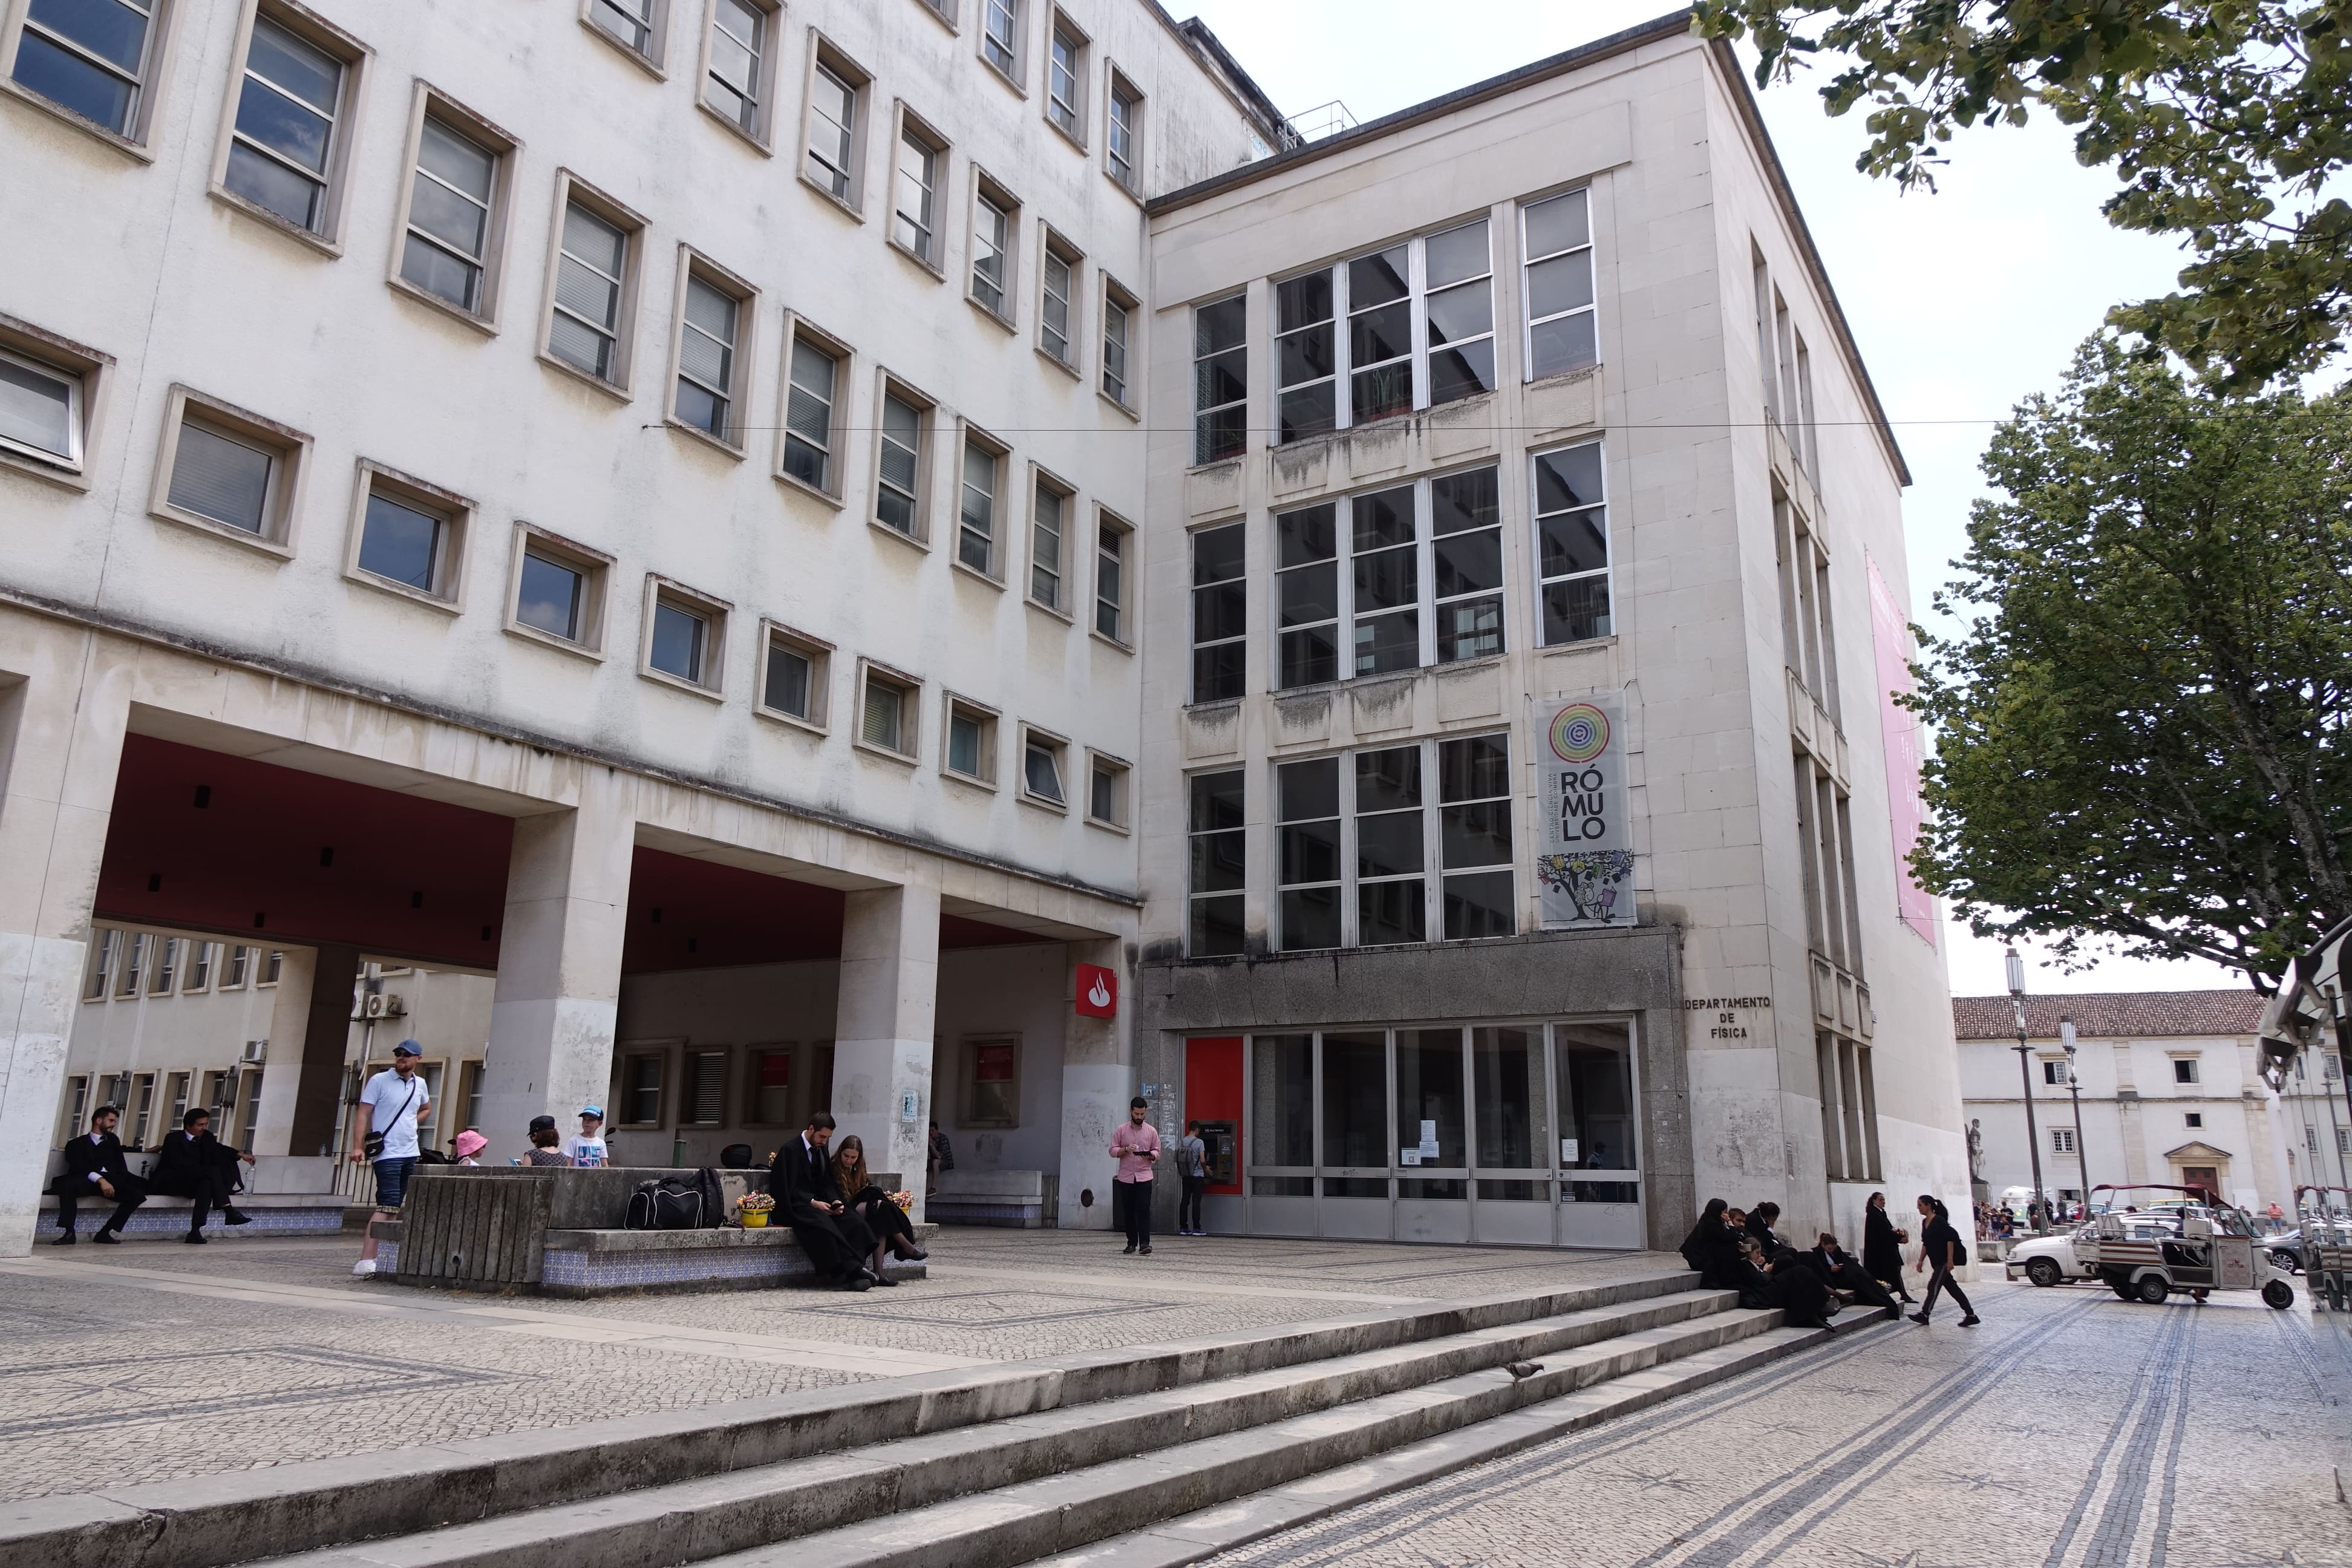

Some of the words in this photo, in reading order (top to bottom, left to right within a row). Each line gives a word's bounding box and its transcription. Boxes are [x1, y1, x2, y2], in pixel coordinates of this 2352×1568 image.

[1561, 763, 1603, 794] RÓ
[1561, 792, 1603, 818] MU
[1563, 817, 1606, 841] LO
[1685, 996, 1770, 1010] DEPARTAMENTO
[1720, 1013, 1734, 1023] DE
[1711, 1026, 1747, 1038] FÍSICA
